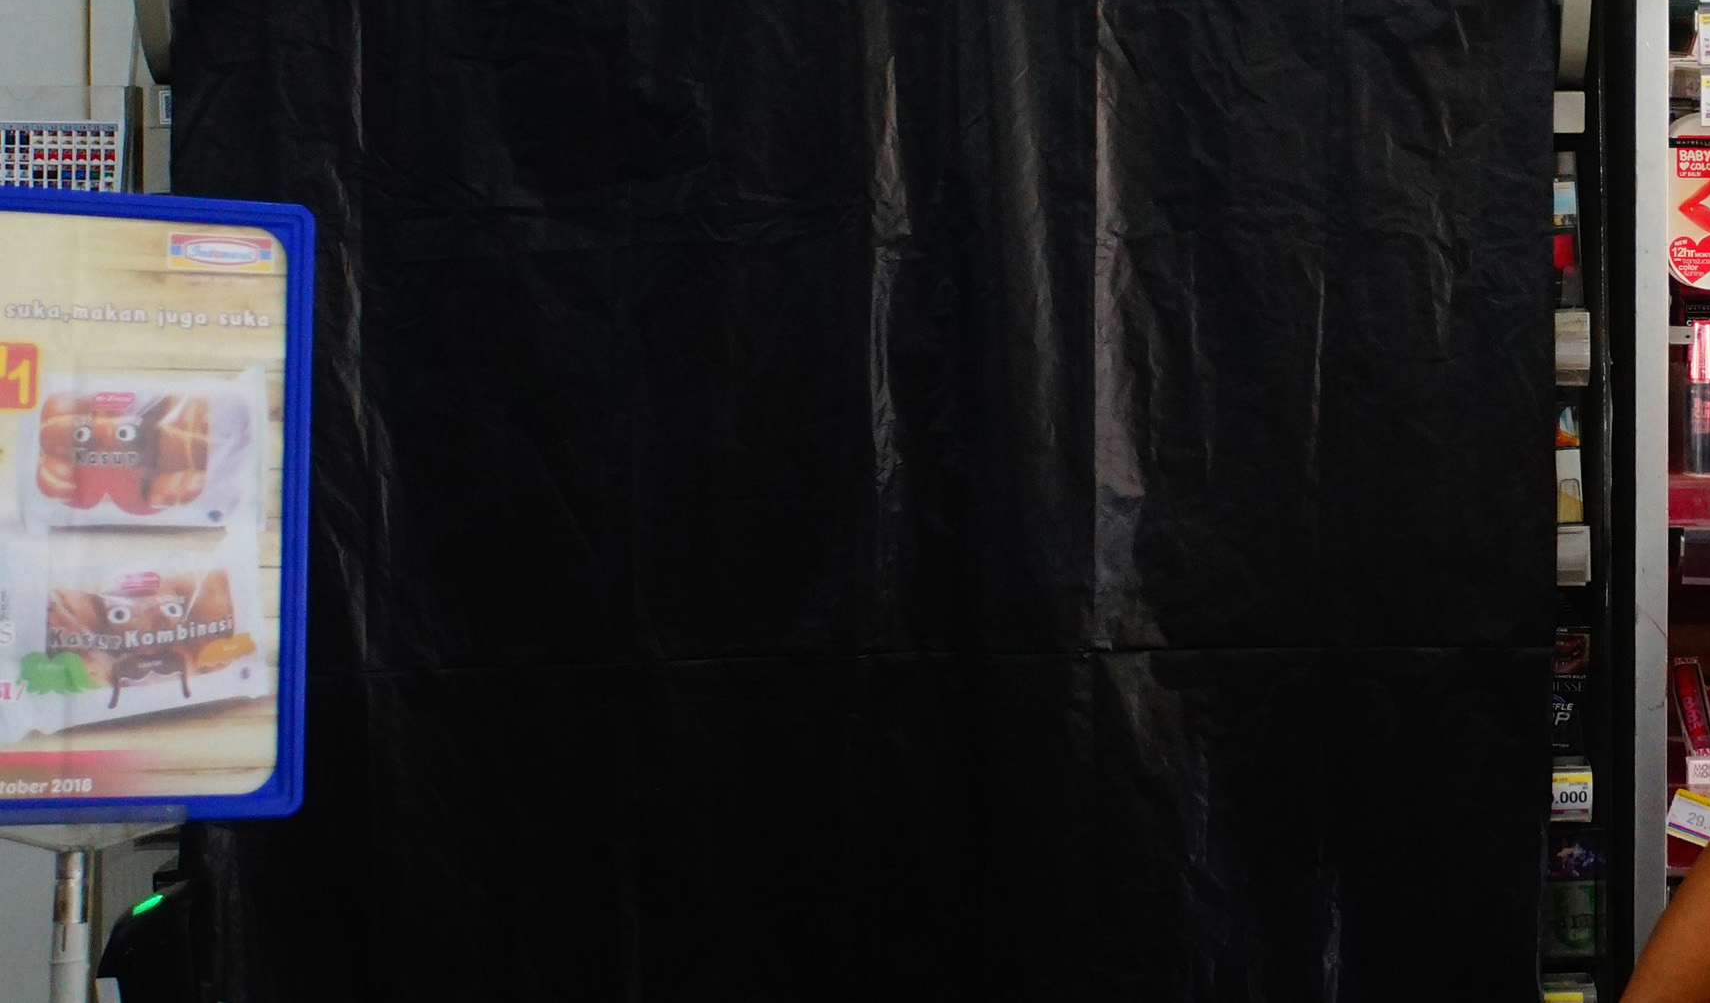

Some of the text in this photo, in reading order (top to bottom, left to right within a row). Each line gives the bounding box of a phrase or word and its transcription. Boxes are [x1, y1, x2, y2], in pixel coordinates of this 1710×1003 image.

[1679, 149, 1710, 162] BABY
[1672, 246, 1696, 258] 12hr
[157, 306, 207, 329] juga
[218, 311, 271, 329] suka
[125, 617, 235, 649] Kombinasi
[50, 778, 93, 794] 2018
